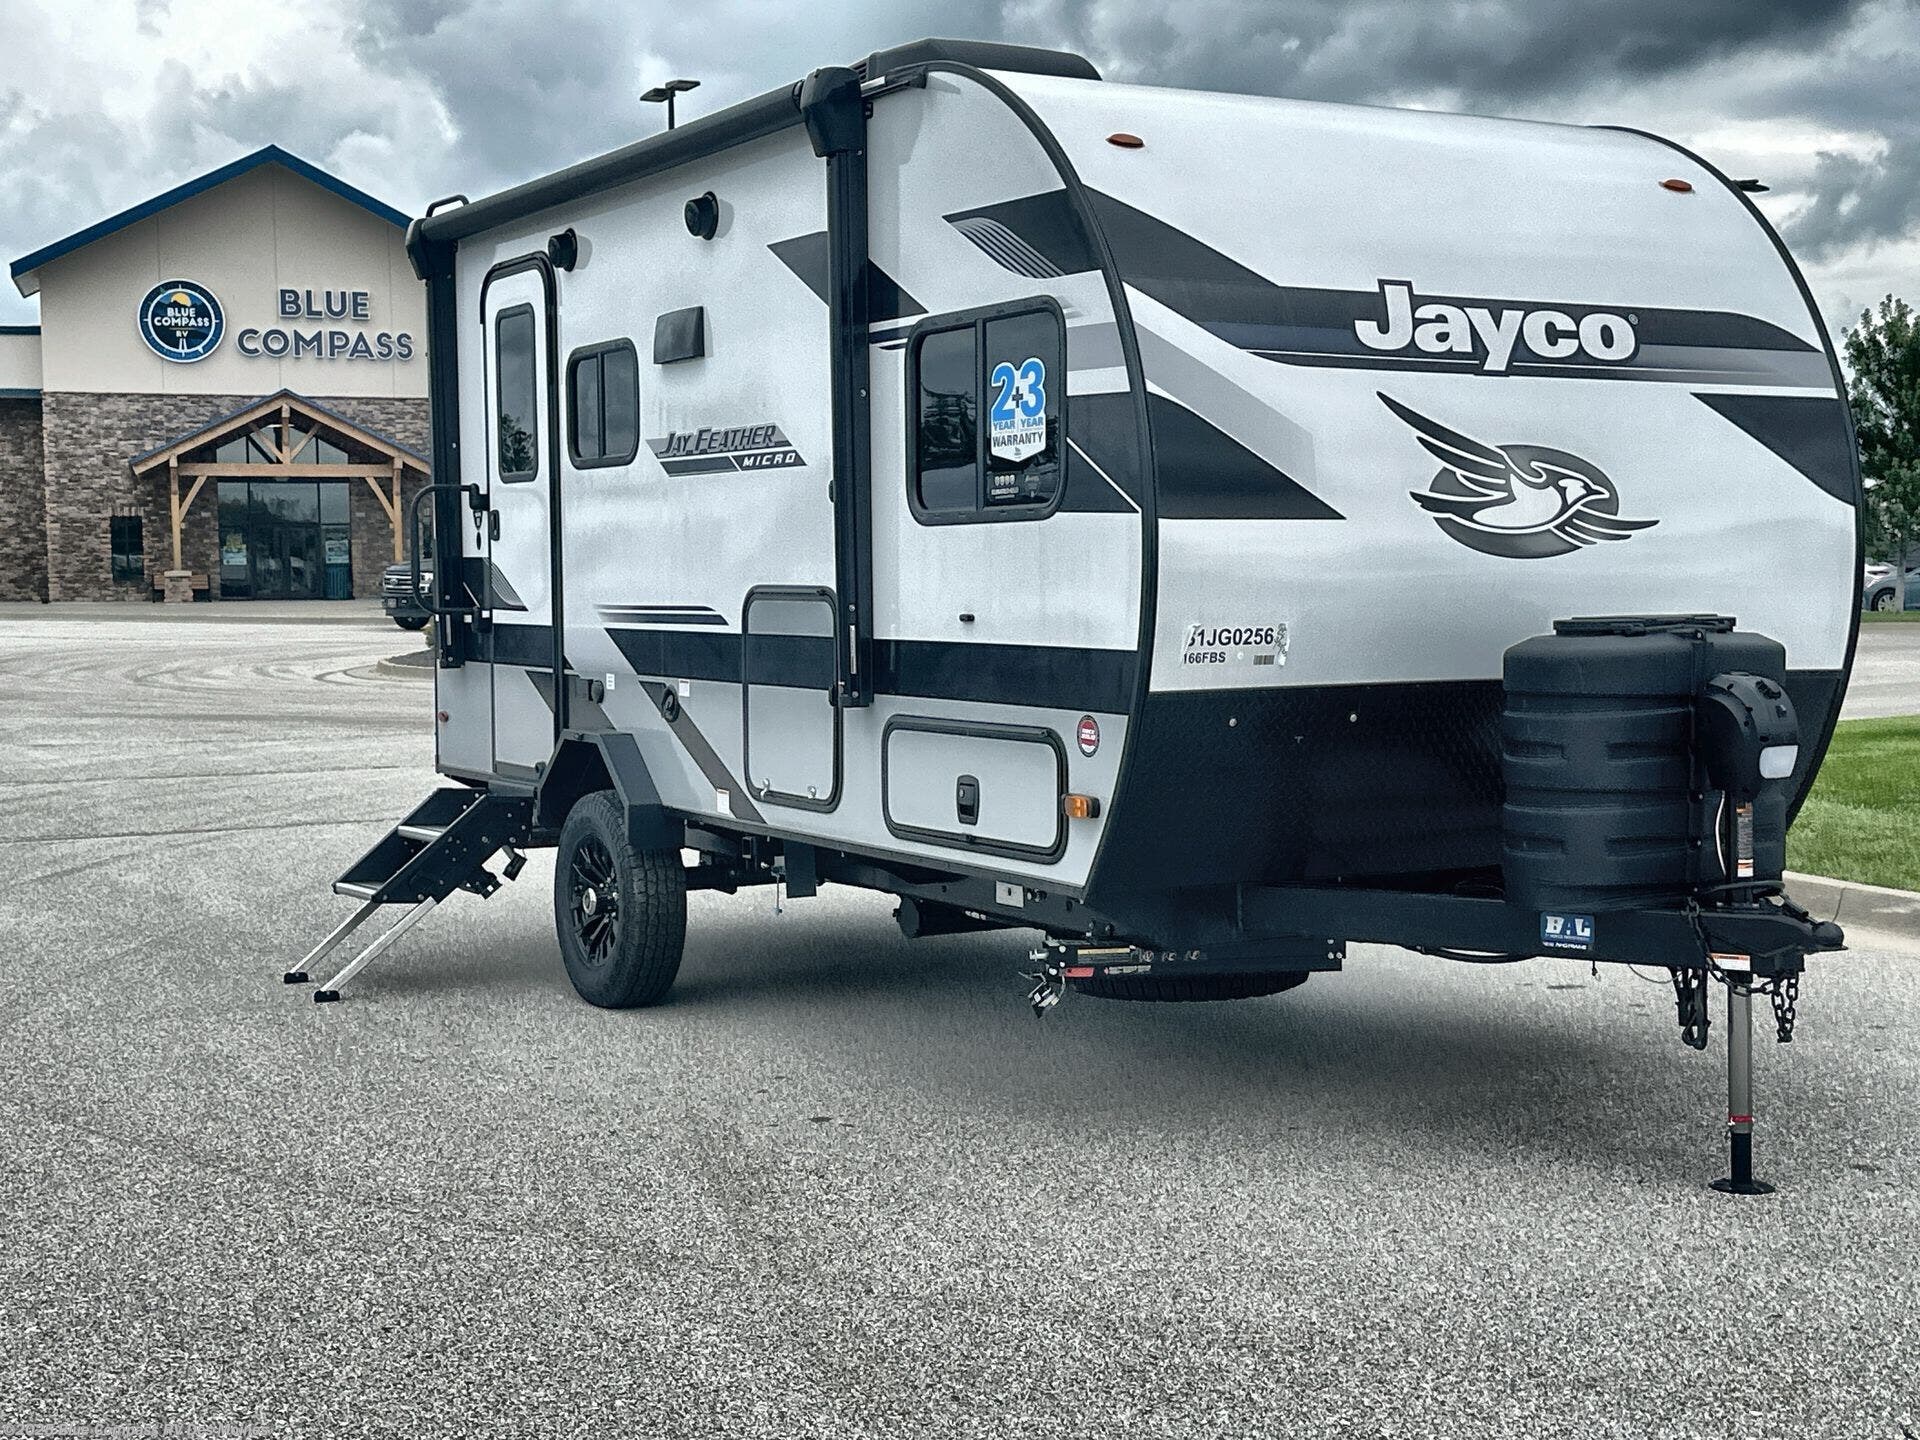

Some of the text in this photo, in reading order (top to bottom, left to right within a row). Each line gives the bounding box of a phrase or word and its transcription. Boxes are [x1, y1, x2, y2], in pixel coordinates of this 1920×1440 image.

[280, 289, 370, 319] BLUE
[167, 307, 196, 317] BLUE
[154, 317, 210, 327] COMPASS
[1354, 284, 1635, 371] Jayco
[176, 330, 188, 338] RV
[238, 329, 413, 359] COMPASS
[993, 416, 1043, 431] YEAR YEAR
[657, 424, 777, 457] JAY FEATHER
[992, 432, 1043, 447] WARRANTY
[742, 452, 796, 467] MICRO
[1183, 651, 1226, 664] 166FBS
